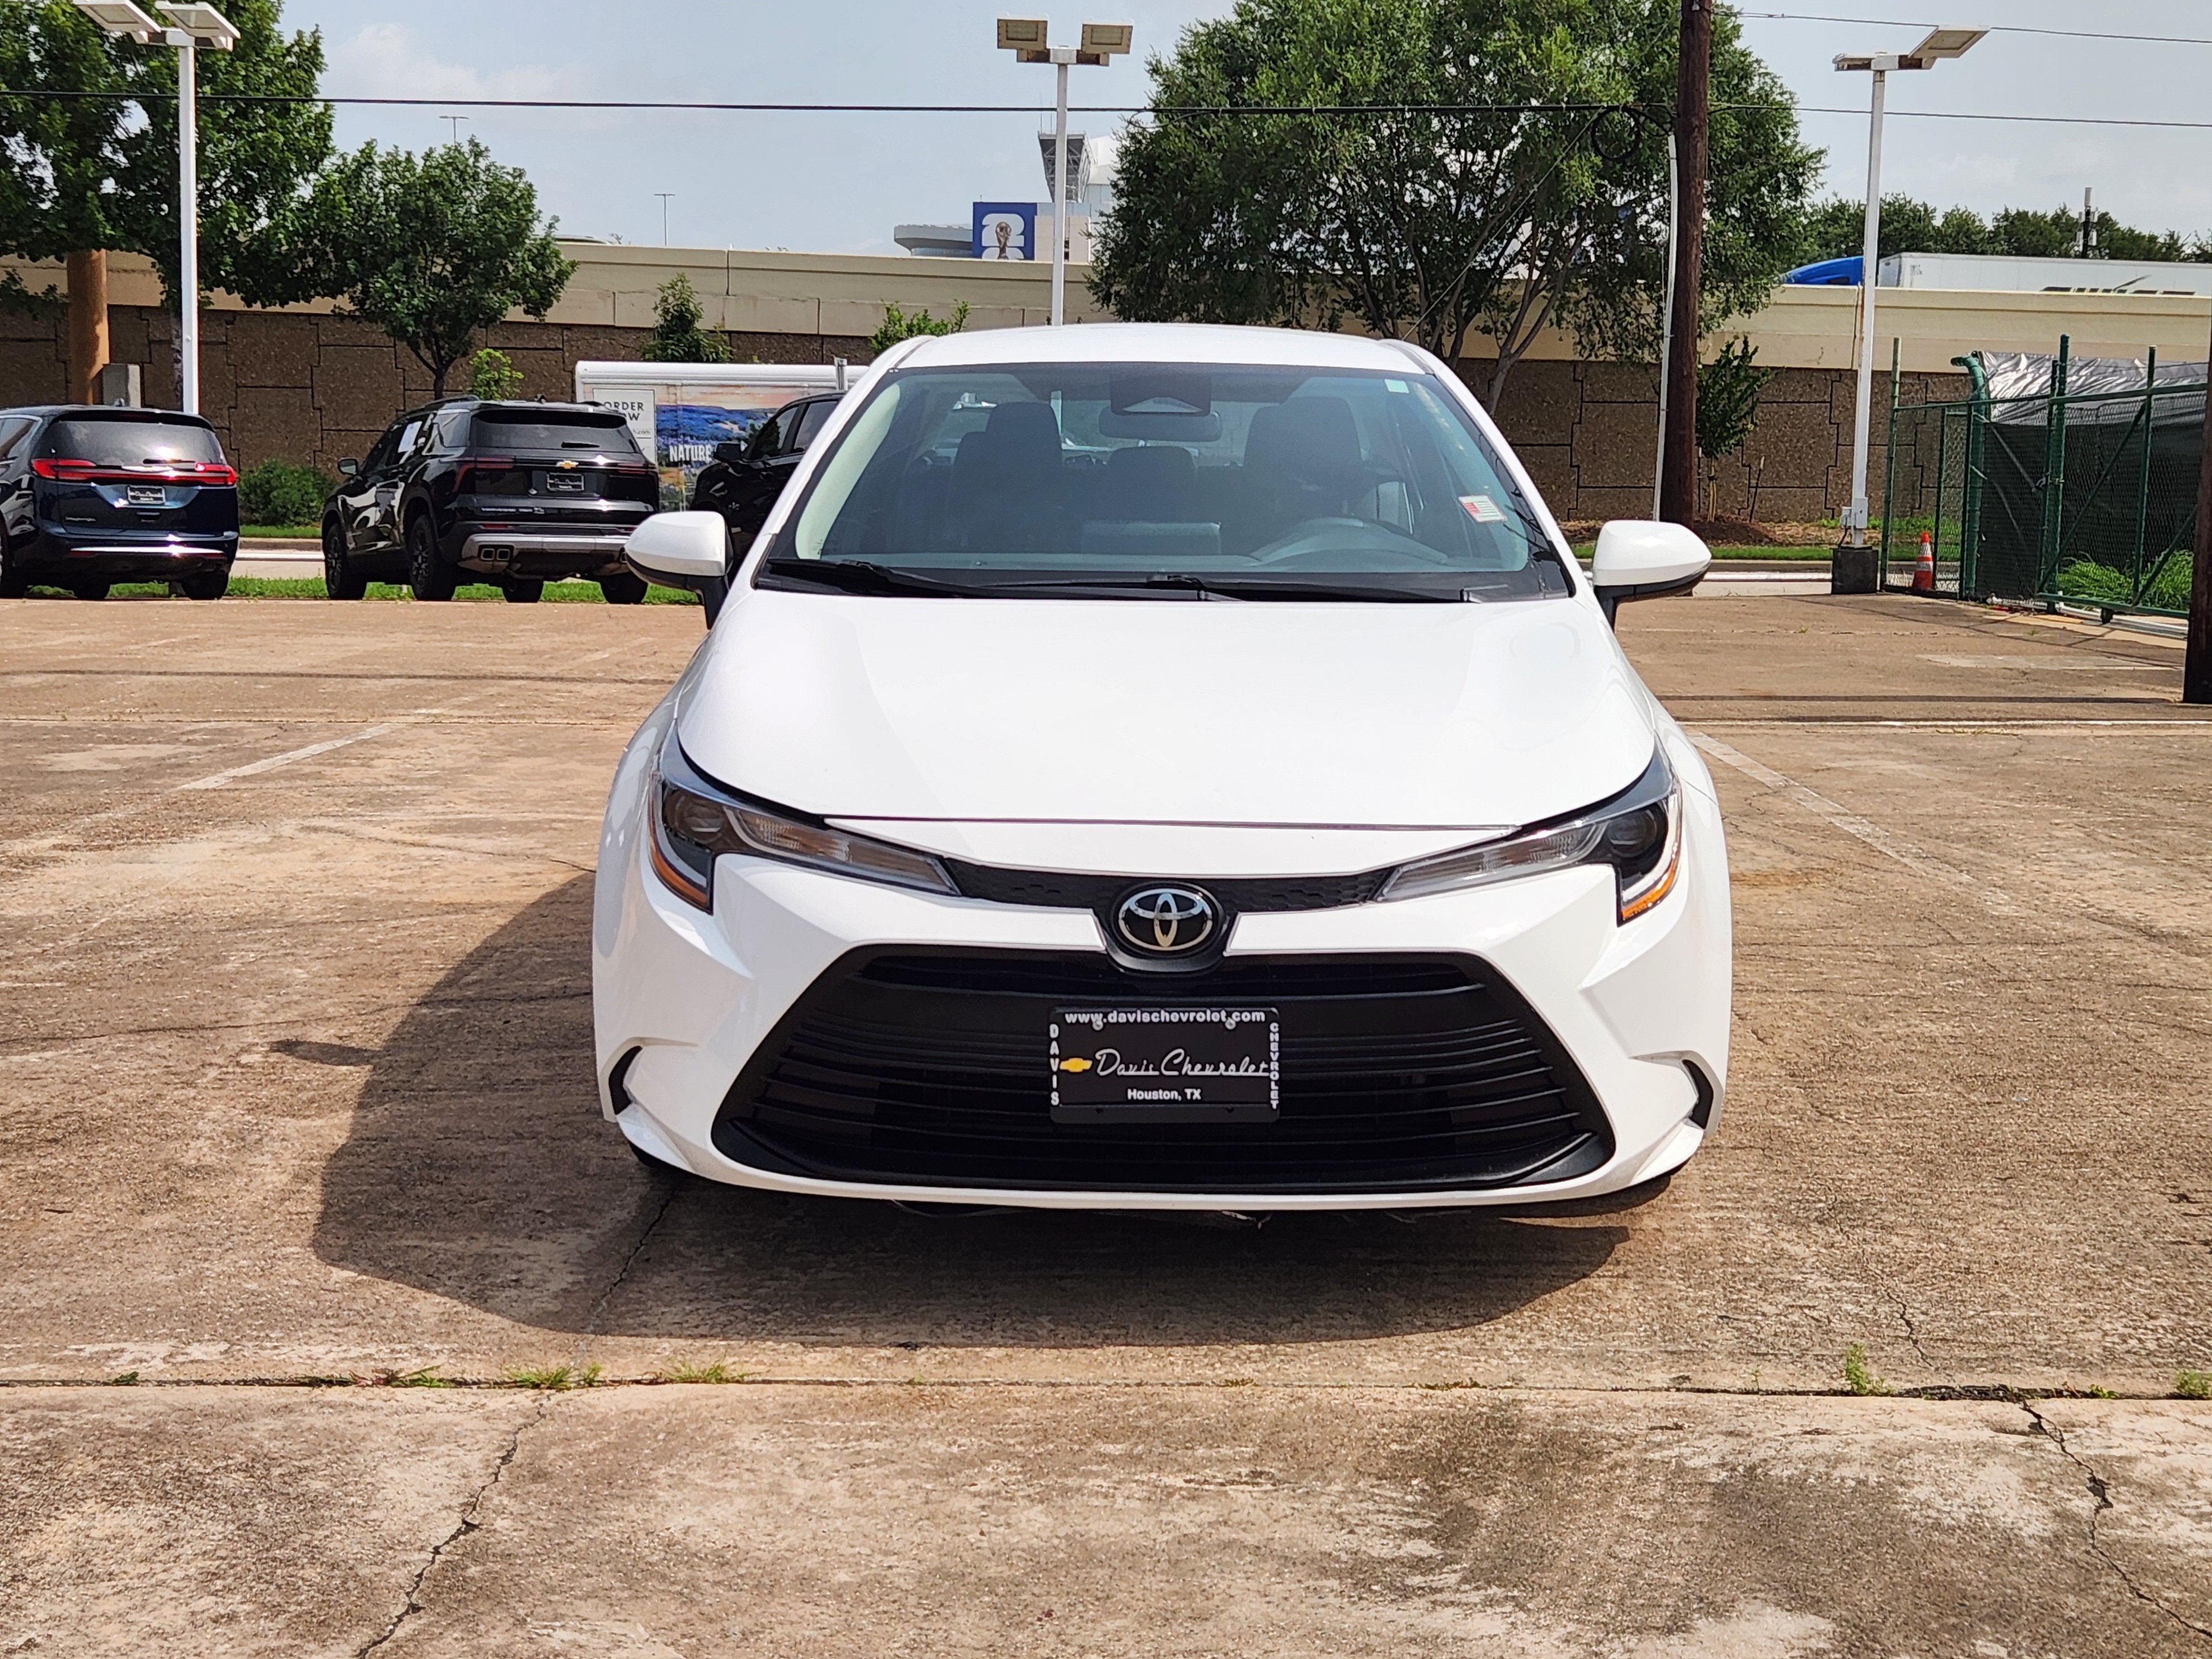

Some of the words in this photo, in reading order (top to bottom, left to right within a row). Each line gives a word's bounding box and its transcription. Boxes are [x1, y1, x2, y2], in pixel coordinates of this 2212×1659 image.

[604, 401, 644, 411] ORDER
[1050, 1024, 1060, 1105] DAVIS
[1095, 1048, 1160, 1076] Davis
[1161, 1048, 1270, 1076] Chevrolet
[1270, 1022, 1279, 1109] CHEVROLET
[1128, 1088, 1182, 1102] Houston,
[1184, 1088, 1201, 1100] TX
